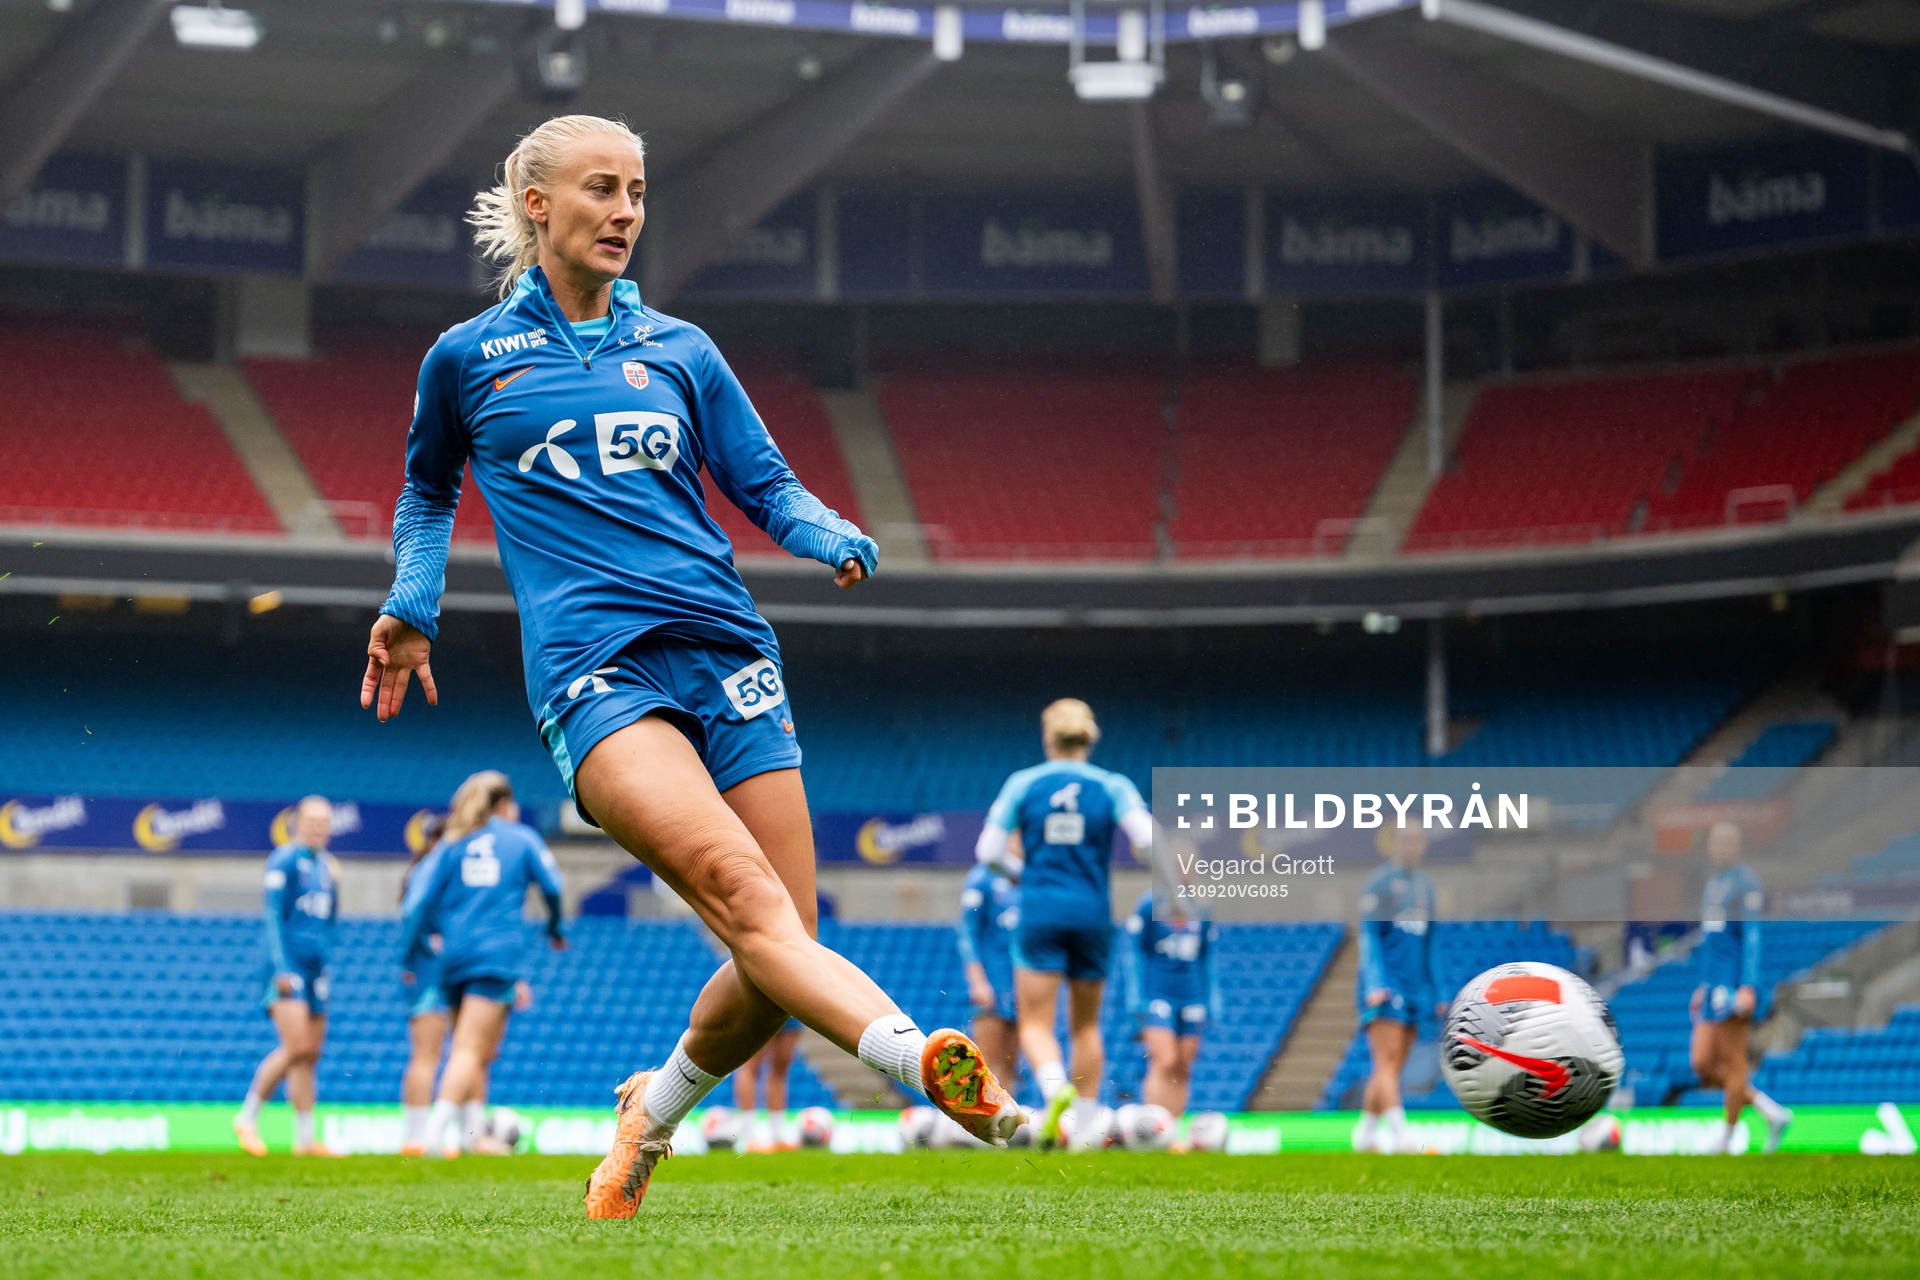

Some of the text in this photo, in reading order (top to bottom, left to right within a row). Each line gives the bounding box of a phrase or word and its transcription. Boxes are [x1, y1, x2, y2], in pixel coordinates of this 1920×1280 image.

[480, 333, 528, 360] KIWI
[530, 337, 549, 349] pris
[609, 423, 672, 461] 5G
[736, 666, 779, 707] 5G
